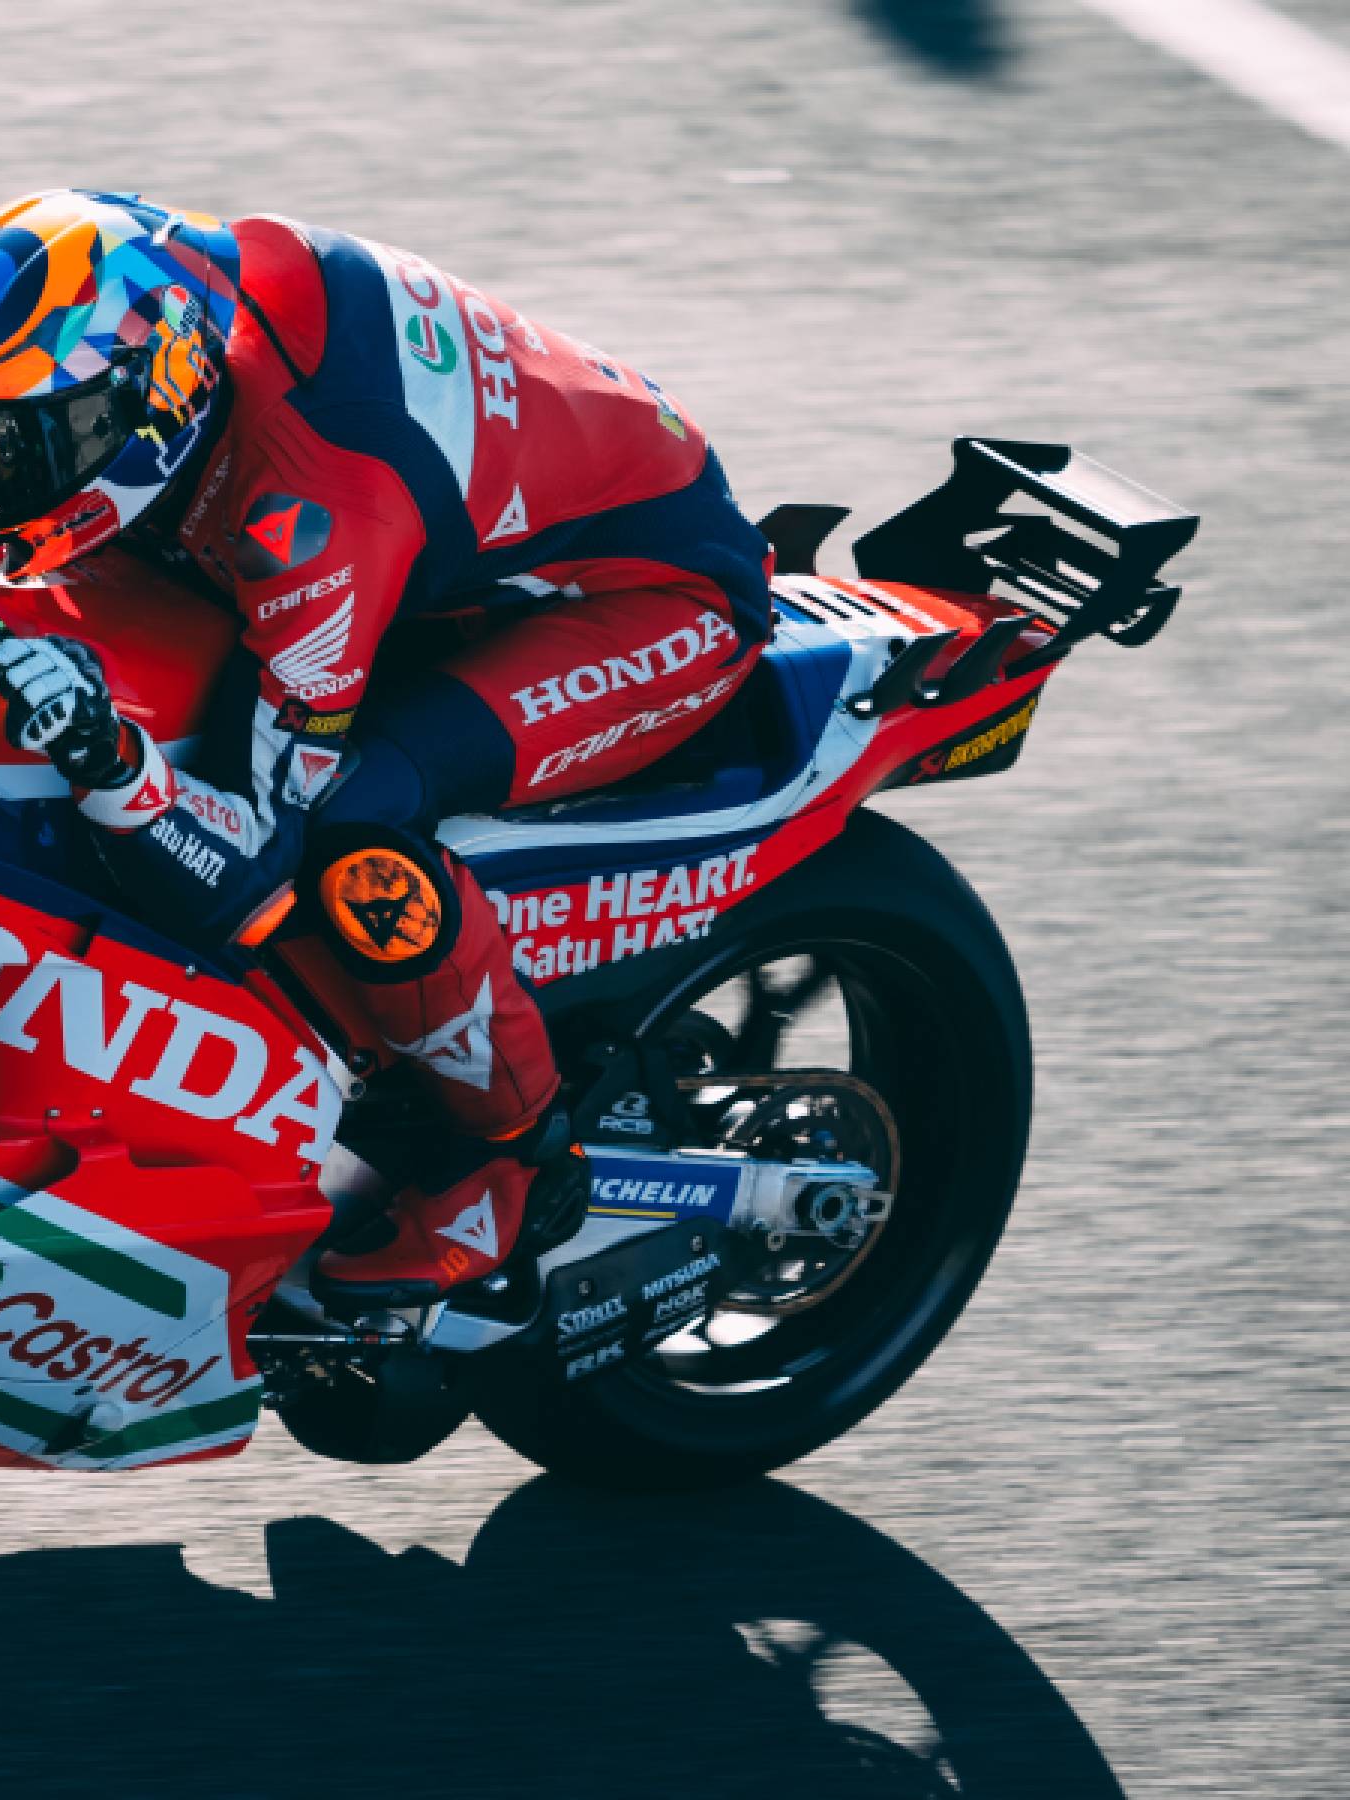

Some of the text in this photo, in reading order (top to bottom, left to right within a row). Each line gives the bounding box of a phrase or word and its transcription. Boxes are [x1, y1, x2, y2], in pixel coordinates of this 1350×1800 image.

[510, 611, 735, 726] HONDA
[149, 817, 185, 858] atu
[585, 842, 760, 922] HEART.
[512, 935, 601, 980] Satu
[590, 1176, 718, 1207] ICHELIN
